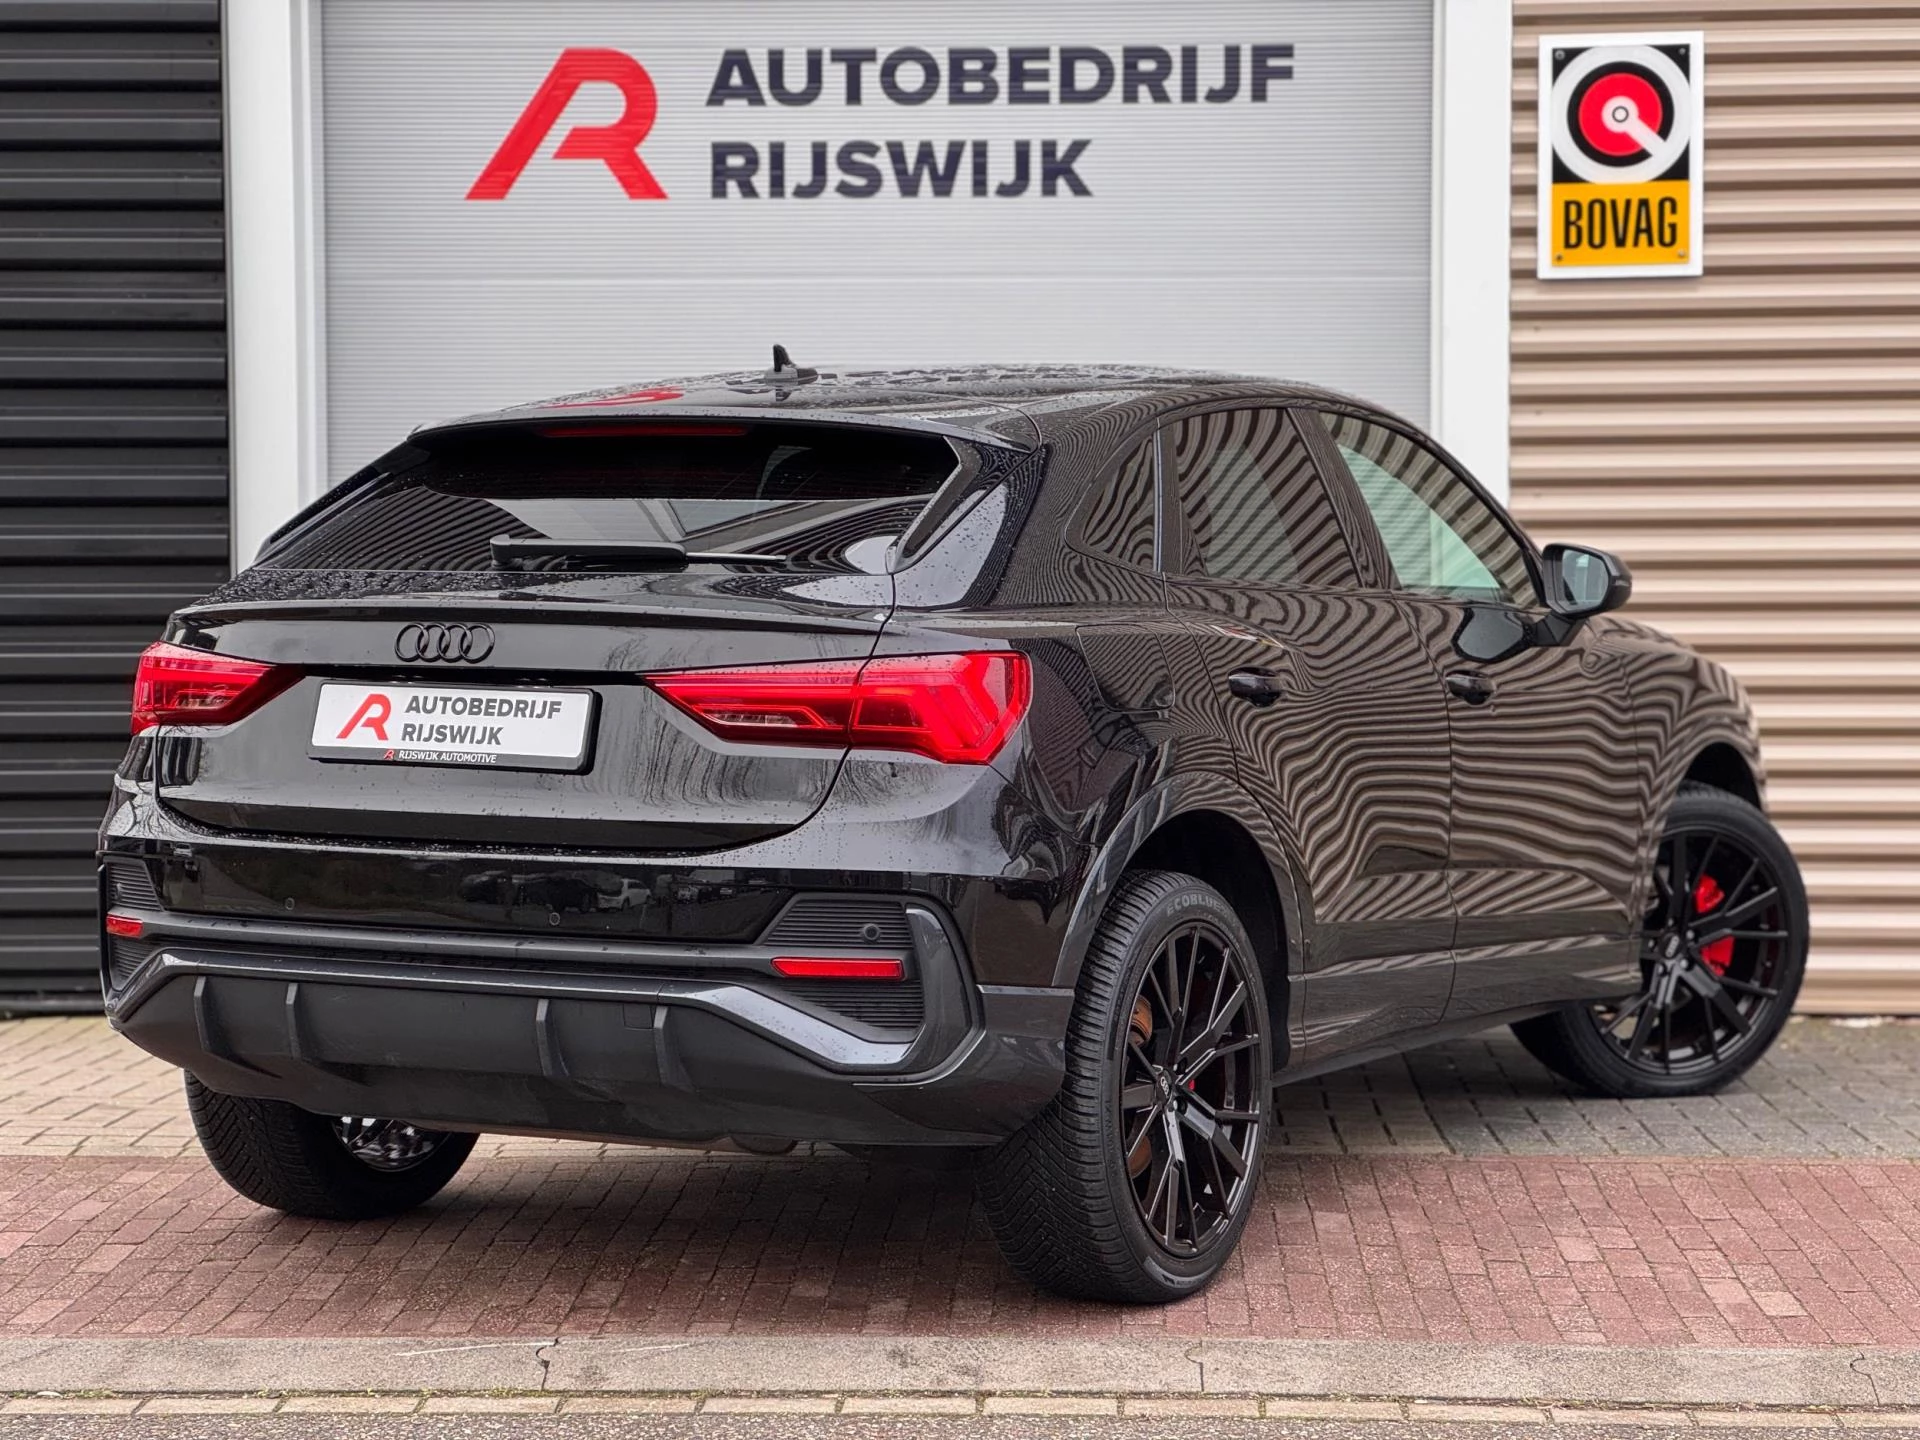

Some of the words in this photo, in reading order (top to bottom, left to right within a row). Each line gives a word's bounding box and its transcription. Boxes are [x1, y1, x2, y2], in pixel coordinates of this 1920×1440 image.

[706, 44, 1294, 106] AUTOBEDRIJF
[711, 139, 1092, 199] RIJSWIJK
[1563, 196, 1678, 250] BOVAG
[405, 695, 562, 720] AUTOBEDRIJF
[401, 723, 504, 746] RIJSWIJK
[399, 750, 439, 761] RIJSWIJK
[440, 752, 498, 763] AUTOMOTIVE
